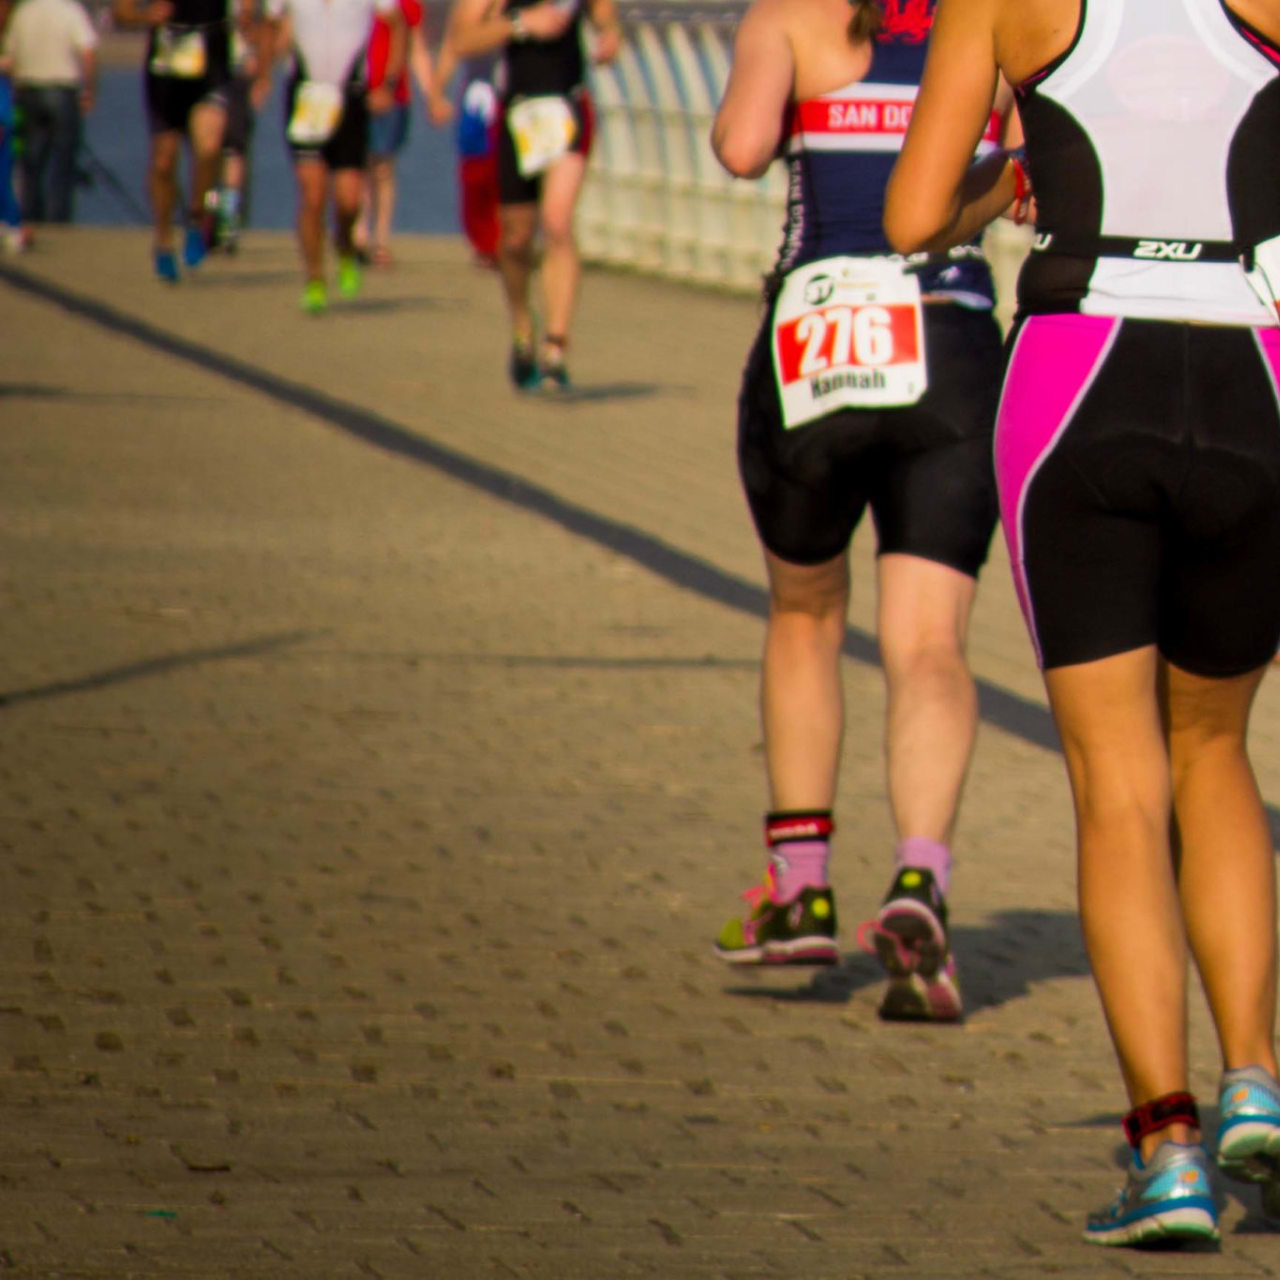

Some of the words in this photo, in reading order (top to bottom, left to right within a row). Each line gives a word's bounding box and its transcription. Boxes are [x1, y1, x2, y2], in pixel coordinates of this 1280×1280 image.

[828, 104, 877, 128] SAN
[1133, 240, 1202, 260] 2XU
[795, 306, 894, 378] 276
[811, 369, 886, 399] Hannah
